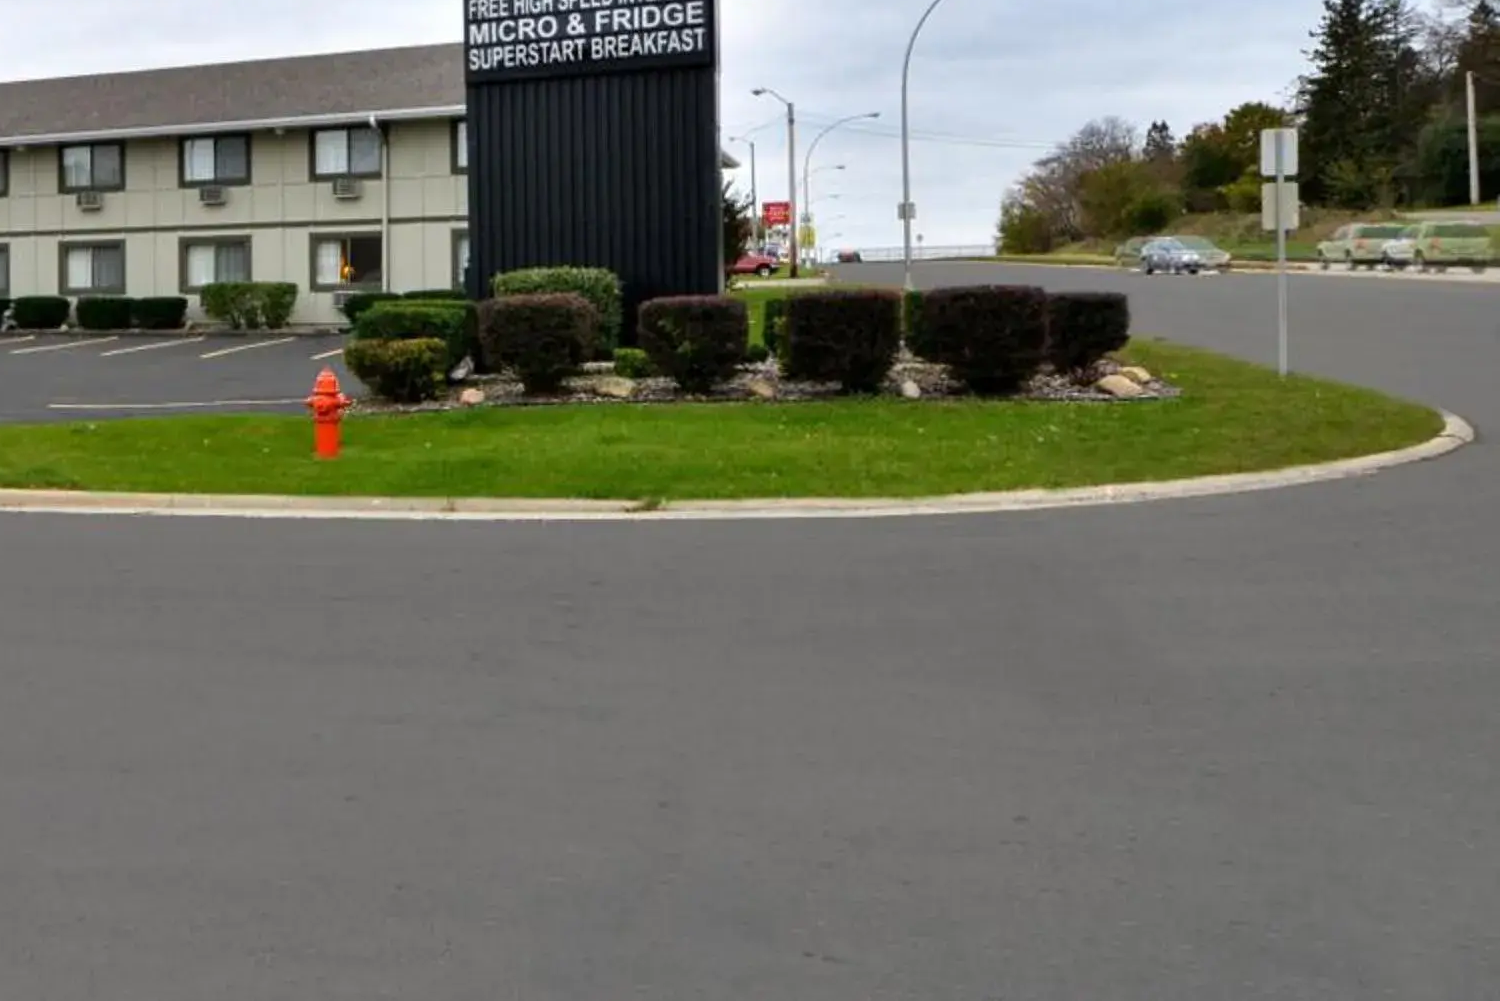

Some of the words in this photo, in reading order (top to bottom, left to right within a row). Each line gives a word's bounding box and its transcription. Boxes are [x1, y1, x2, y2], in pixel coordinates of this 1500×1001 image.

[468, 15, 559, 46] MICRO
[566, 12, 586, 36] &
[595, 0, 705, 33] FRIDGE
[468, 37, 587, 72] SUPERSTART
[590, 27, 707, 61] BREAKFAST
